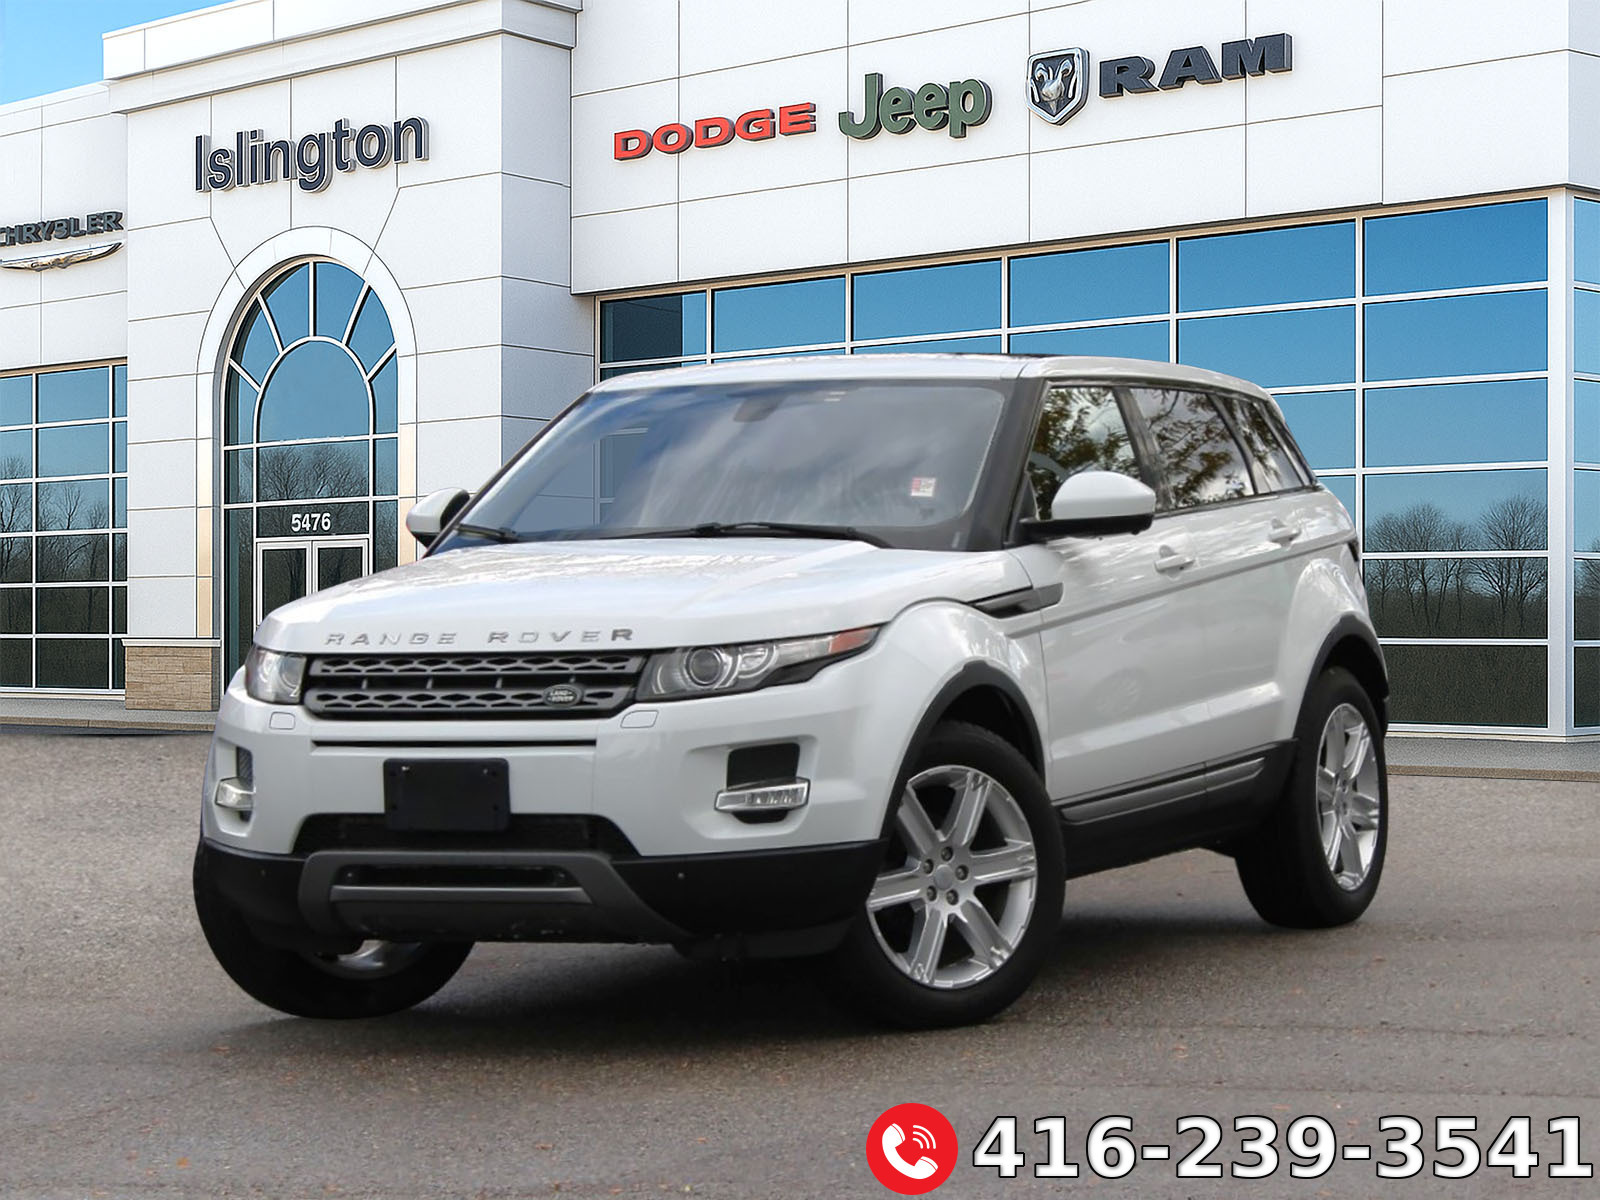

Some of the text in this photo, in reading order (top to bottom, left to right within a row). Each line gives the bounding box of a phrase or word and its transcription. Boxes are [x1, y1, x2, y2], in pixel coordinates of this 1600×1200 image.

[1099, 32, 1293, 98] RAM
[613, 102, 817, 161] DODGE
[838, 73, 992, 141] Jeep
[195, 116, 430, 192] Islington
[291, 512, 331, 532] 5476
[325, 628, 634, 645] RANGE ROVER
